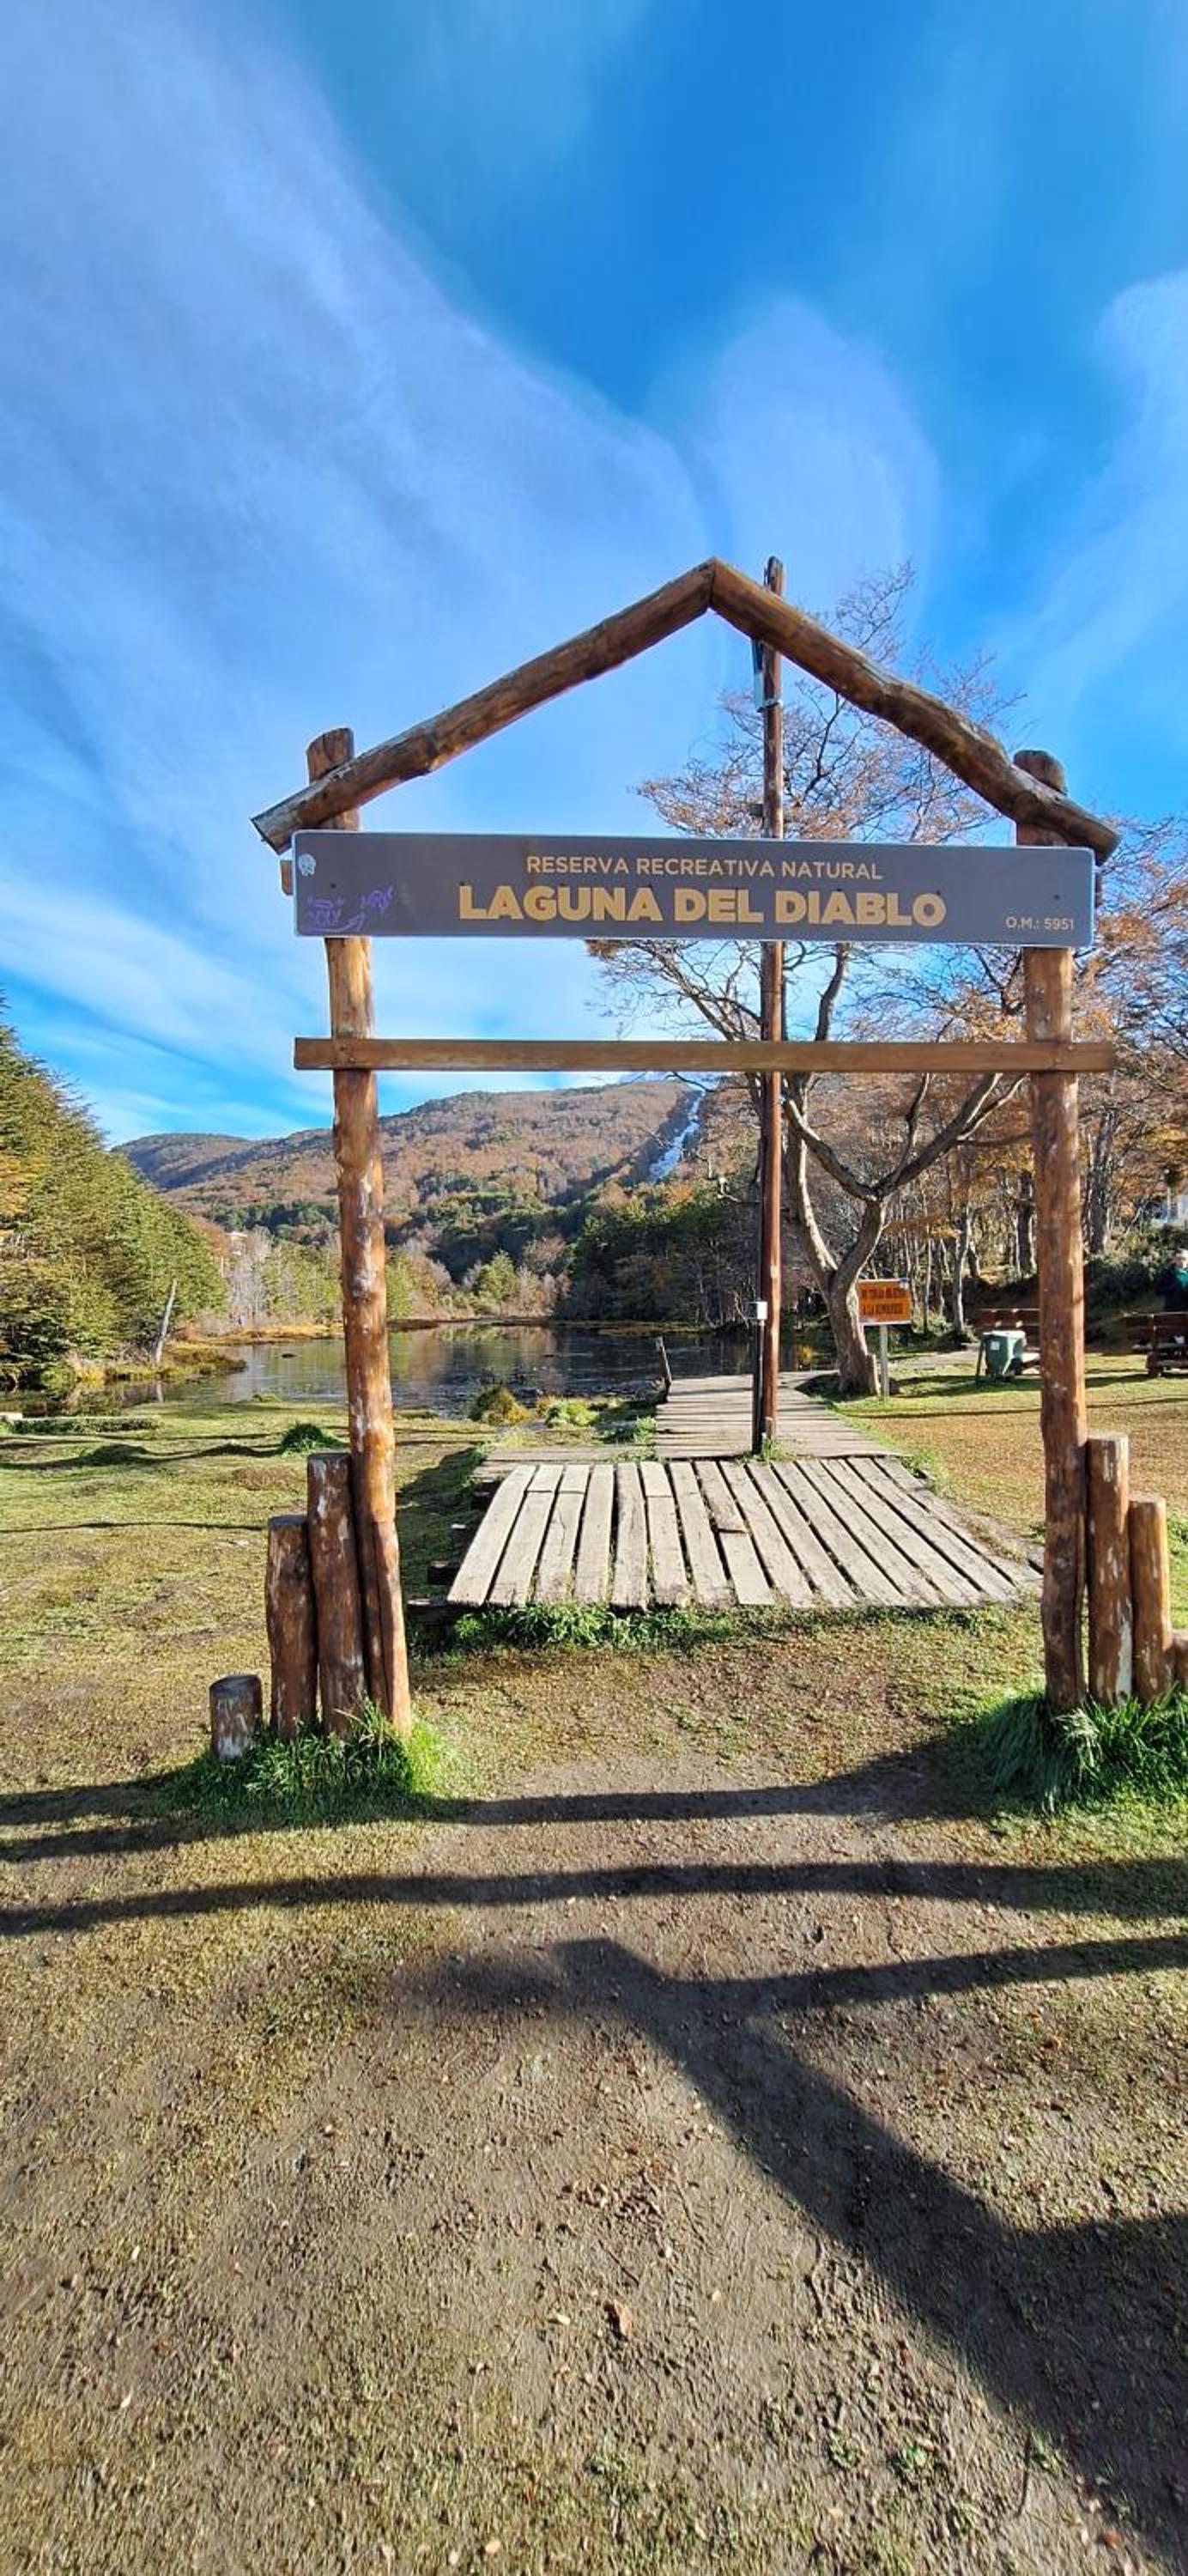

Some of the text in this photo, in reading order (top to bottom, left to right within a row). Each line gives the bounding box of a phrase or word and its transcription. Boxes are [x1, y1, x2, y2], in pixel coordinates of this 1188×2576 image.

[526, 856, 883, 880] RESERVA RECREATIVA NATURAL
[458, 885, 947, 927] LAGUNA DEL DIABLO
